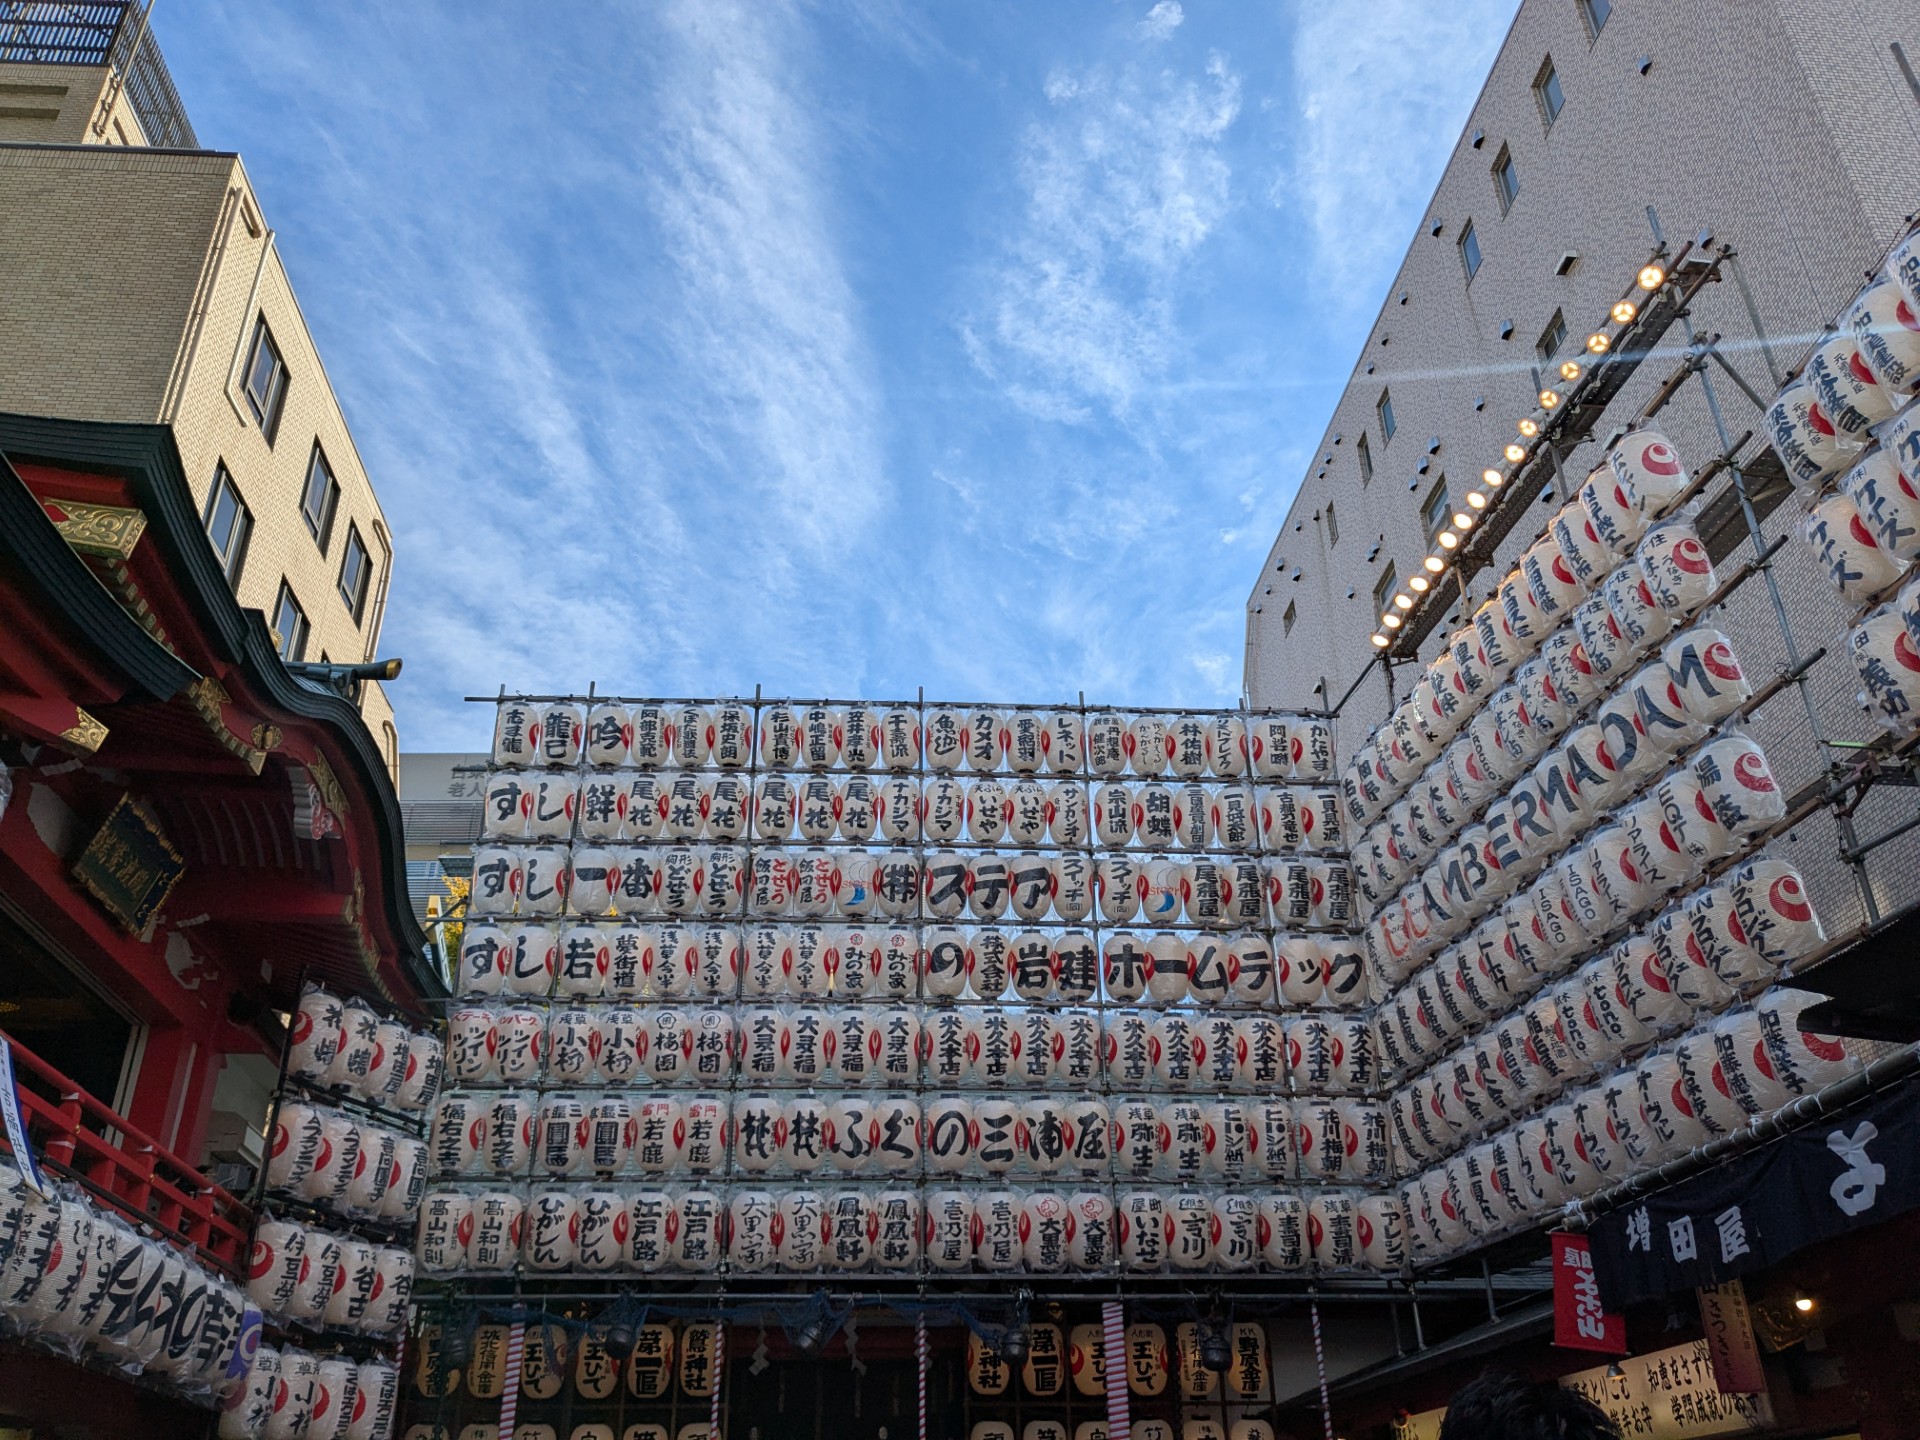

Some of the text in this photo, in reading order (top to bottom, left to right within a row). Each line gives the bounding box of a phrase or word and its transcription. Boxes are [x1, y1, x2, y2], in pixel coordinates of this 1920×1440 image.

[1662, 554, 1685, 586] うなぎ
[591, 716, 624, 749] 吟
[974, 714, 994, 760] カメオ
[1057, 718, 1076, 764] レネット
[1310, 725, 1329, 771] かたやま
[628, 783, 654, 826] 尾花
[671, 781, 695, 827] 尾花
[711, 782, 738, 828] 尾花
[761, 782, 786, 828] 尾花
[805, 782, 830, 829] 尾花
[845, 782, 869, 829] 尾花
[892, 783, 910, 832] ナカジマ
[935, 783, 953, 831] ナカジマ
[979, 795, 998, 834] いせや
[1146, 791, 1172, 837] 胡蝶
[708, 863, 736, 909] どぜう
[755, 857, 771, 906] 飯田屋
[799, 858, 815, 904] 飯田屋
[1064, 859, 1084, 901] スイッチ
[1111, 860, 1132, 905] スイッチ
[1567, 863, 1596, 920] ISAGO
[1538, 888, 1566, 944] ISAGO
[613, 933, 639, 988] 夢街道
[657, 930, 679, 988] 浅草今半
[703, 931, 723, 988] 浅草今半
[754, 931, 776, 989] 浅草今半
[796, 931, 818, 989] 浅草今半
[844, 946, 866, 989] みの家
[887, 948, 909, 989] みの家
[980, 935, 1005, 992] 株式会社
[938, 1015, 962, 1076] 米久本店
[984, 1016, 1009, 1076] 米久本店
[1026, 1016, 1050, 1076] 米久本店
[1069, 1018, 1094, 1078] 米久本店
[1123, 1018, 1147, 1079] 米久本店
[1166, 1020, 1190, 1080] 米久本店
[1211, 1021, 1235, 1081] 米久本店
[1252, 1021, 1278, 1081] 米久本店
[1305, 1022, 1330, 1082] 米久本店
[1348, 1024, 1372, 1084] 米久本店
[1128, 1107, 1155, 1121] 浅草
[1174, 1107, 1201, 1121] 浅草
[1604, 1087, 1645, 1160] オーヴァル
[1636, 1070, 1675, 1143] オーヴァル
[831, 1108, 1107, 1163] ふぐの三浦屋
[1130, 1122, 1155, 1168] 弥生
[1176, 1123, 1201, 1170] 弥生
[1544, 1118, 1576, 1186] オーヴァル
[1573, 1103, 1611, 1174] オーヴァル
[534, 1197, 565, 1263] ひがしん
[580, 1198, 611, 1264] ひがしん
[632, 1199, 662, 1262] 江戸路
[683, 1199, 712, 1261] 江戸路
[835, 1197, 864, 1262] 鳳凰軒
[883, 1198, 911, 1262] 鳳凰軒
[1273, 1201, 1302, 1214] 浅草
[1324, 1200, 1352, 1213] 浅草
[1039, 1218, 1062, 1265] 大黒家
[1083, 1219, 1107, 1265] 大黒家
[1135, 1215, 1160, 1264] いなせ
[1626, 1205, 1751, 1264] 増田屋
[479, 1329, 501, 1393] 城北信用金庫
[524, 1343, 544, 1393] 玉ひで
[583, 1343, 605, 1393] 玉ひで
[1133, 1340, 1157, 1390] 玉ひで
[1238, 1337, 1261, 1392] 野原金庫
